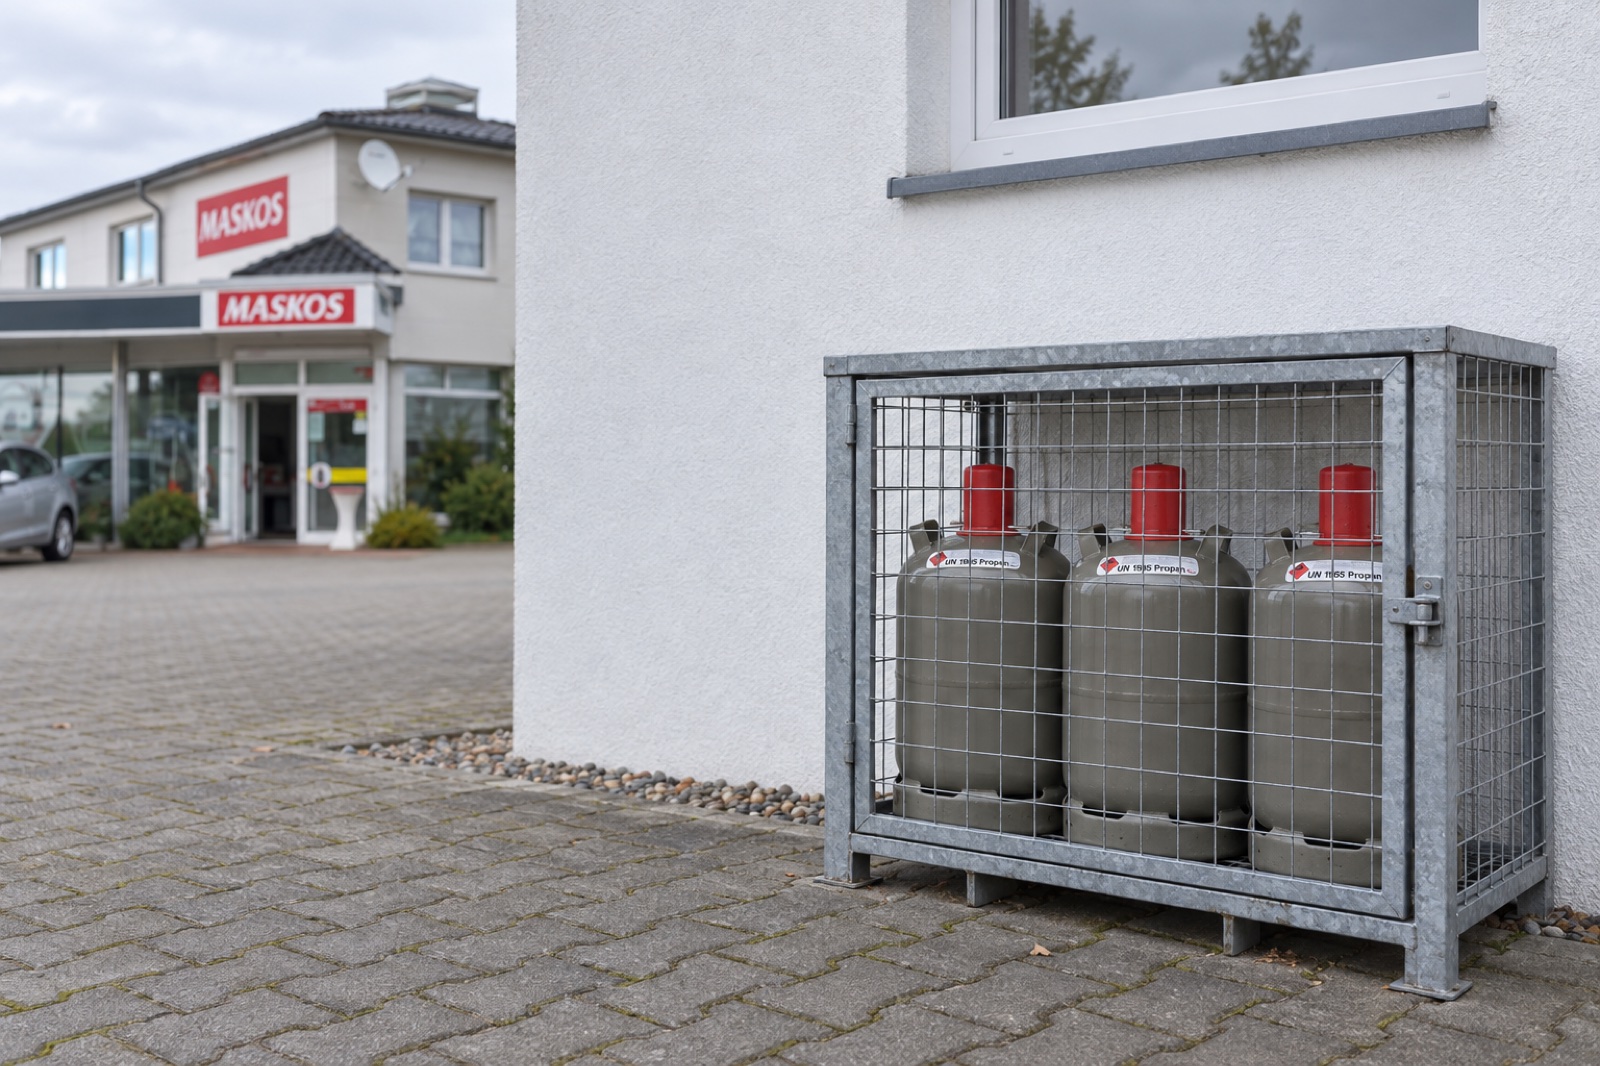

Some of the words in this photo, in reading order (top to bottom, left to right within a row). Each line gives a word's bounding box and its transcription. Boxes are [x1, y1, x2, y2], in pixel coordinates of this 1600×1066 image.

[199, 191, 284, 242] MASKOS
[222, 292, 345, 324] MASKOS
[1117, 564, 1130, 572] UN
[1154, 564, 1186, 573] Propan
